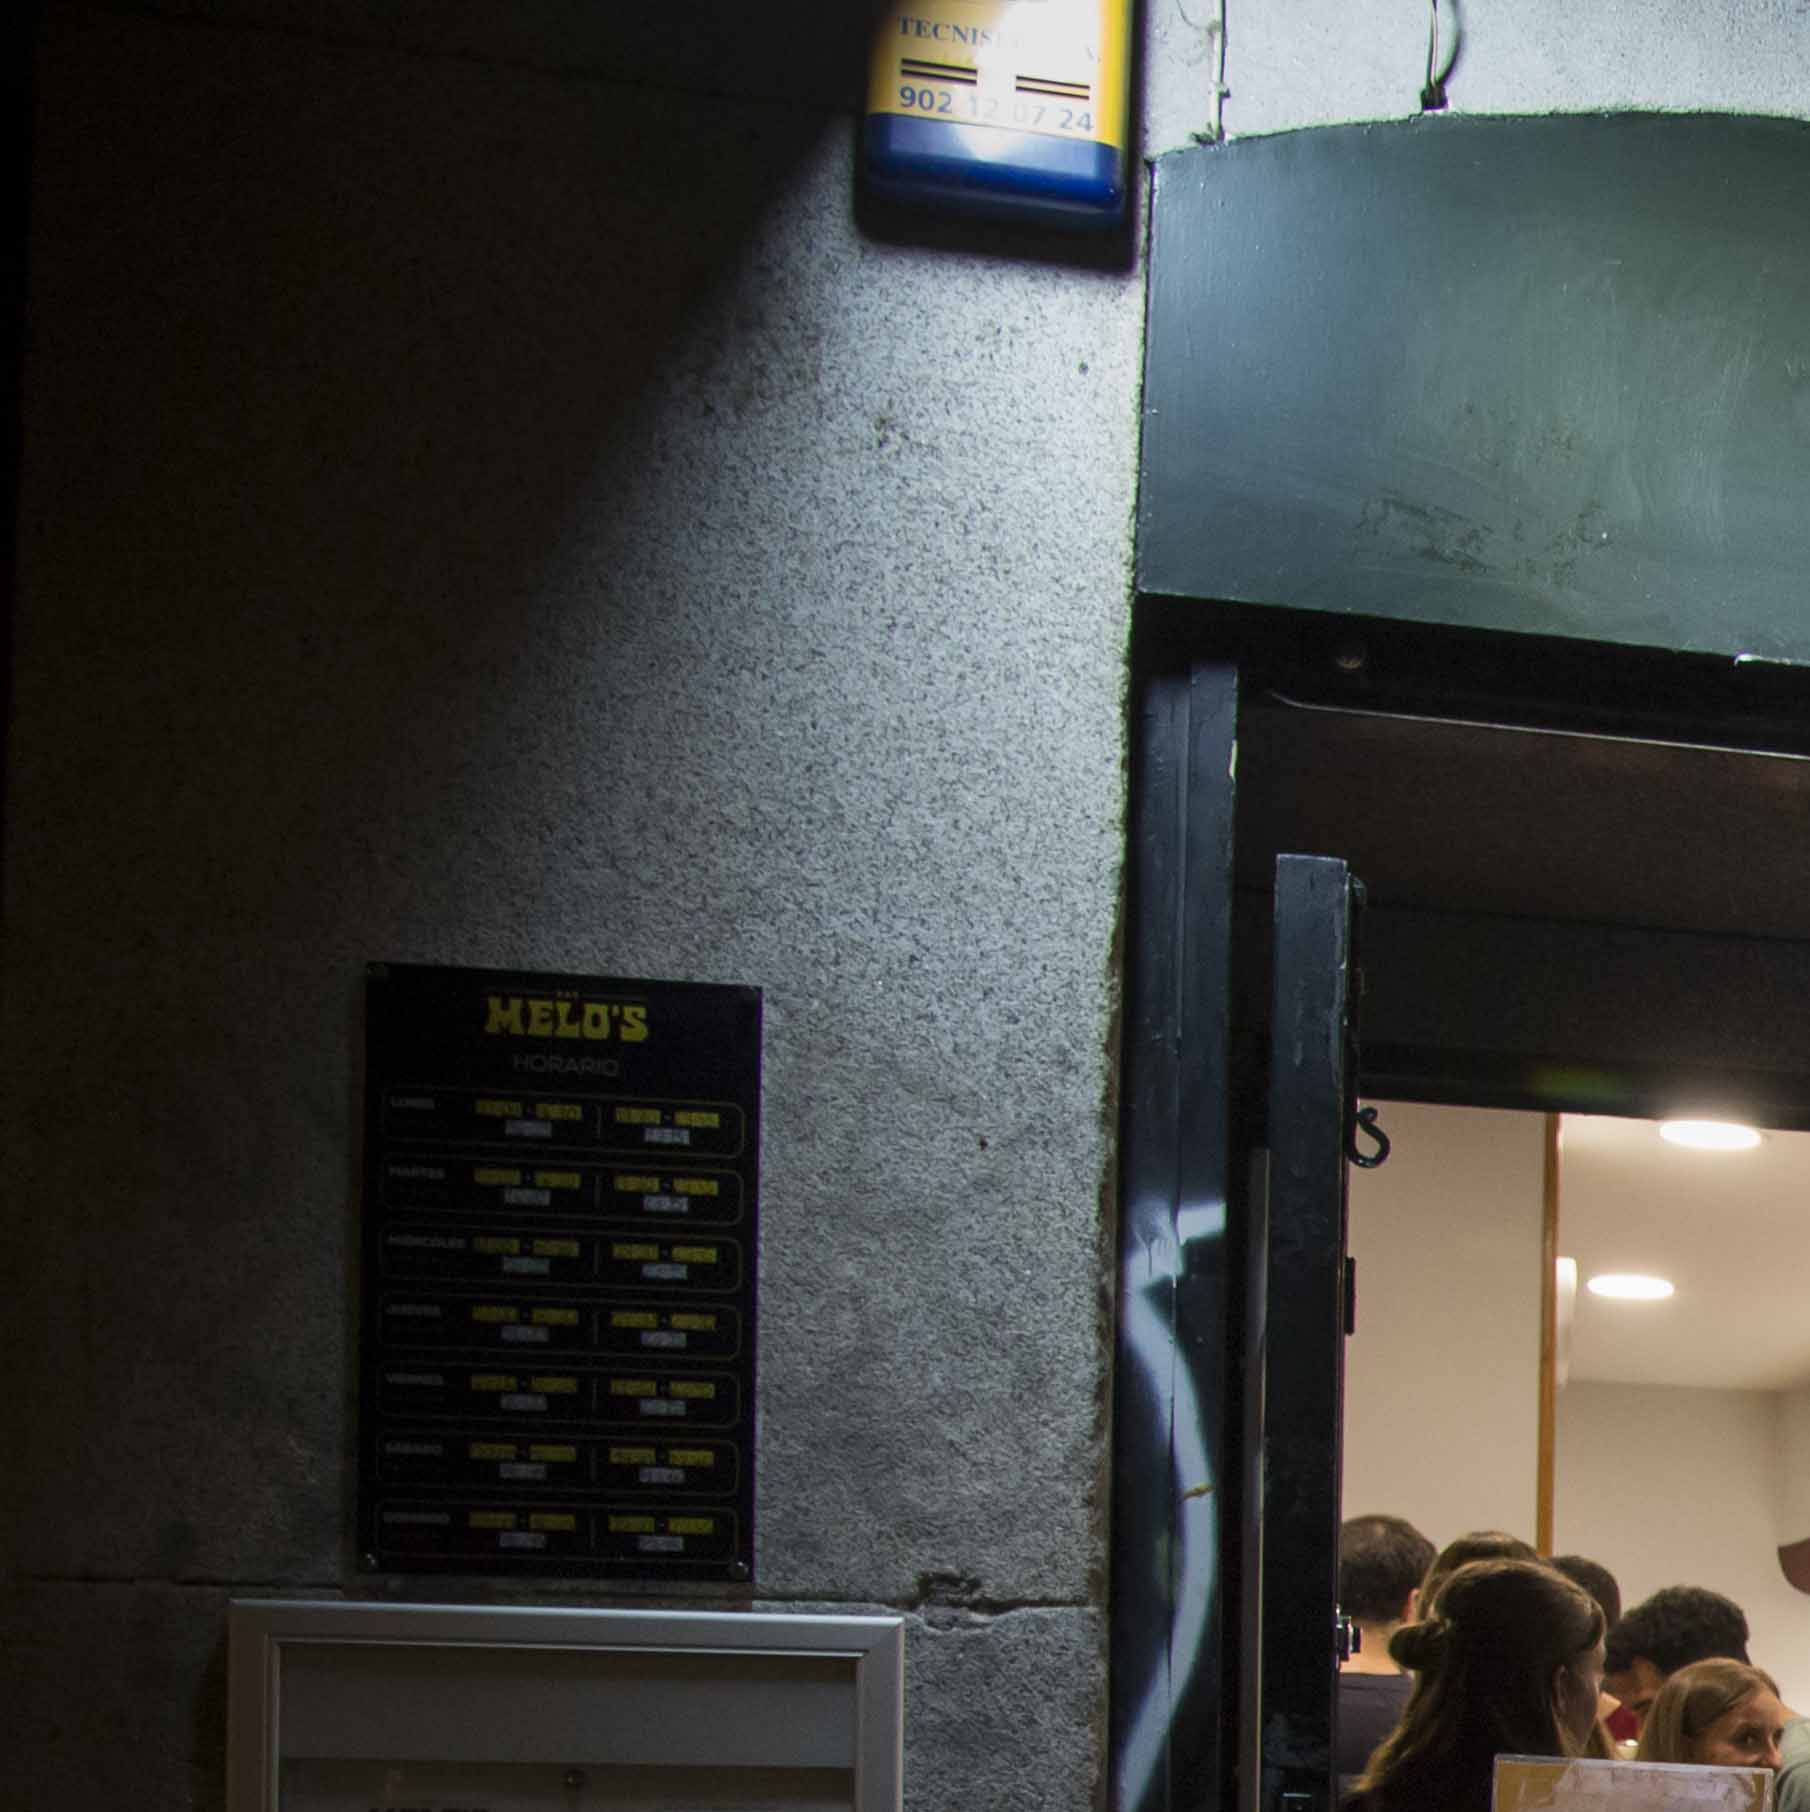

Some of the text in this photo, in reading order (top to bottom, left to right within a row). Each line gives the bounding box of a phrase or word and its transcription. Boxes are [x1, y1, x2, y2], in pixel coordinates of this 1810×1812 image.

[899, 85, 953, 115] 902
[967, 95, 1001, 118] 12
[1057, 108, 1094, 132] 24
[485, 998, 650, 1043] MELO'S
[512, 1054, 620, 1077] HORARIO
